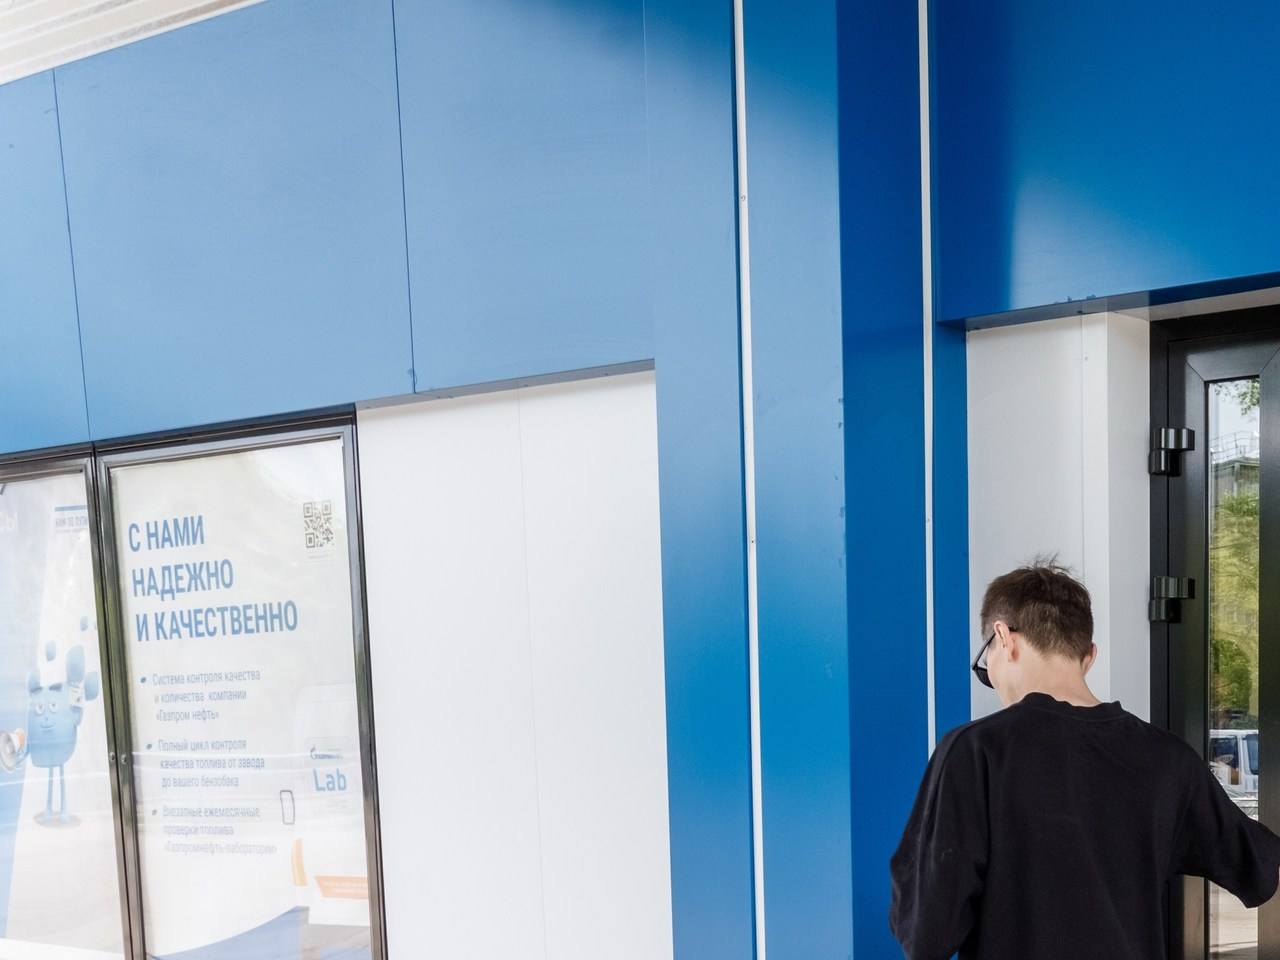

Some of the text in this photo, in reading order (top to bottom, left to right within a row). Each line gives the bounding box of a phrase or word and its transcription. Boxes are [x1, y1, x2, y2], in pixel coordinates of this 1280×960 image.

[129, 515, 205, 552] С НАМИ
[132, 559, 234, 602] НАДЕЖНО
[136, 600, 298, 642] И КАЧЕСТВЕННО
[152, 670, 261, 686] Система контроля качества
[161, 692, 205, 704] количества
[208, 690, 247, 702] компании
[156, 707, 220, 724] «Газпром нефть»
[158, 739, 247, 752] Полный цикл контроля
[160, 758, 265, 771] качества топлива от завода
[161, 774, 239, 789] до вашего бензобака
[312, 768, 347, 792] Lab
[200, 825, 234, 836] топлива
